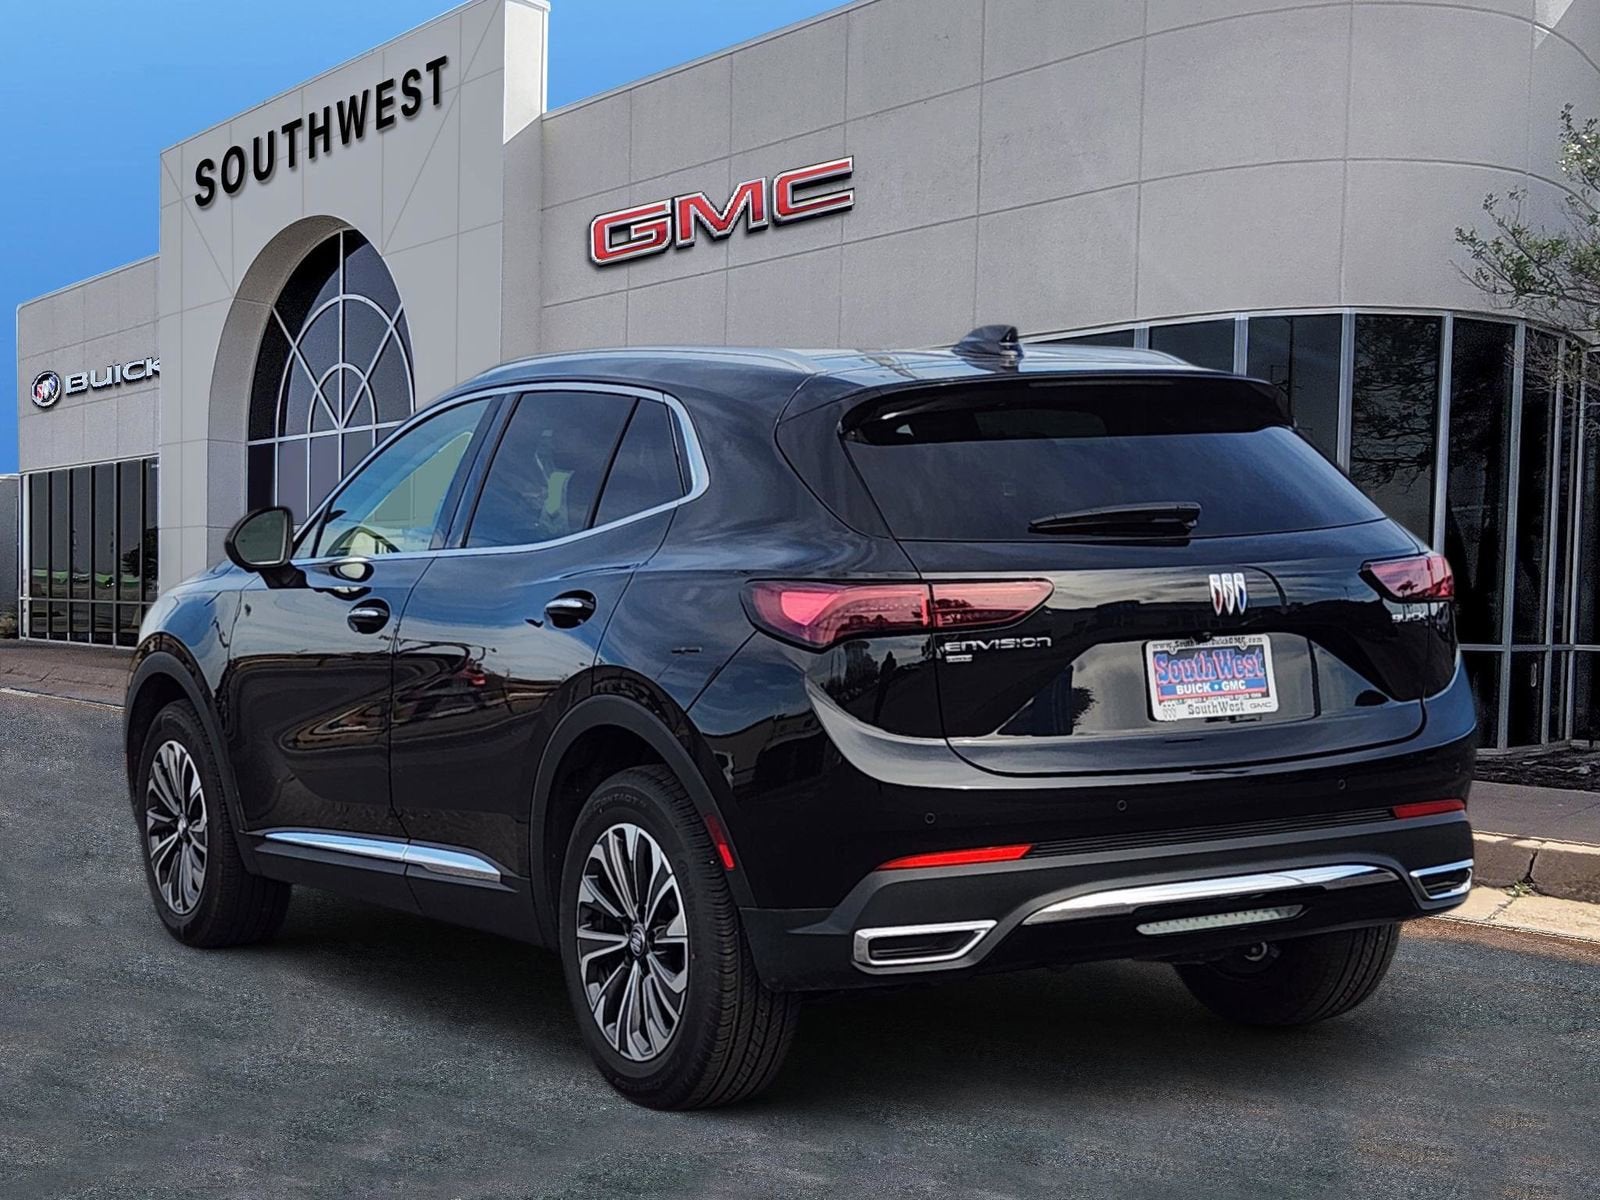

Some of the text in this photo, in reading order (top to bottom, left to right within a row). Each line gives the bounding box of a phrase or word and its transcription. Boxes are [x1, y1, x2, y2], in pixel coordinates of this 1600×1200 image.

[195, 55, 448, 207] SOUTHWEST
[589, 155, 855, 267] GMC
[65, 356, 160, 395] BUICK
[944, 637, 1052, 652] ENVISION
[1154, 648, 1265, 684] SouthWest
[1176, 679, 1246, 695] BUICK GMC
[1188, 701, 1272, 715] SouthWest GMC
